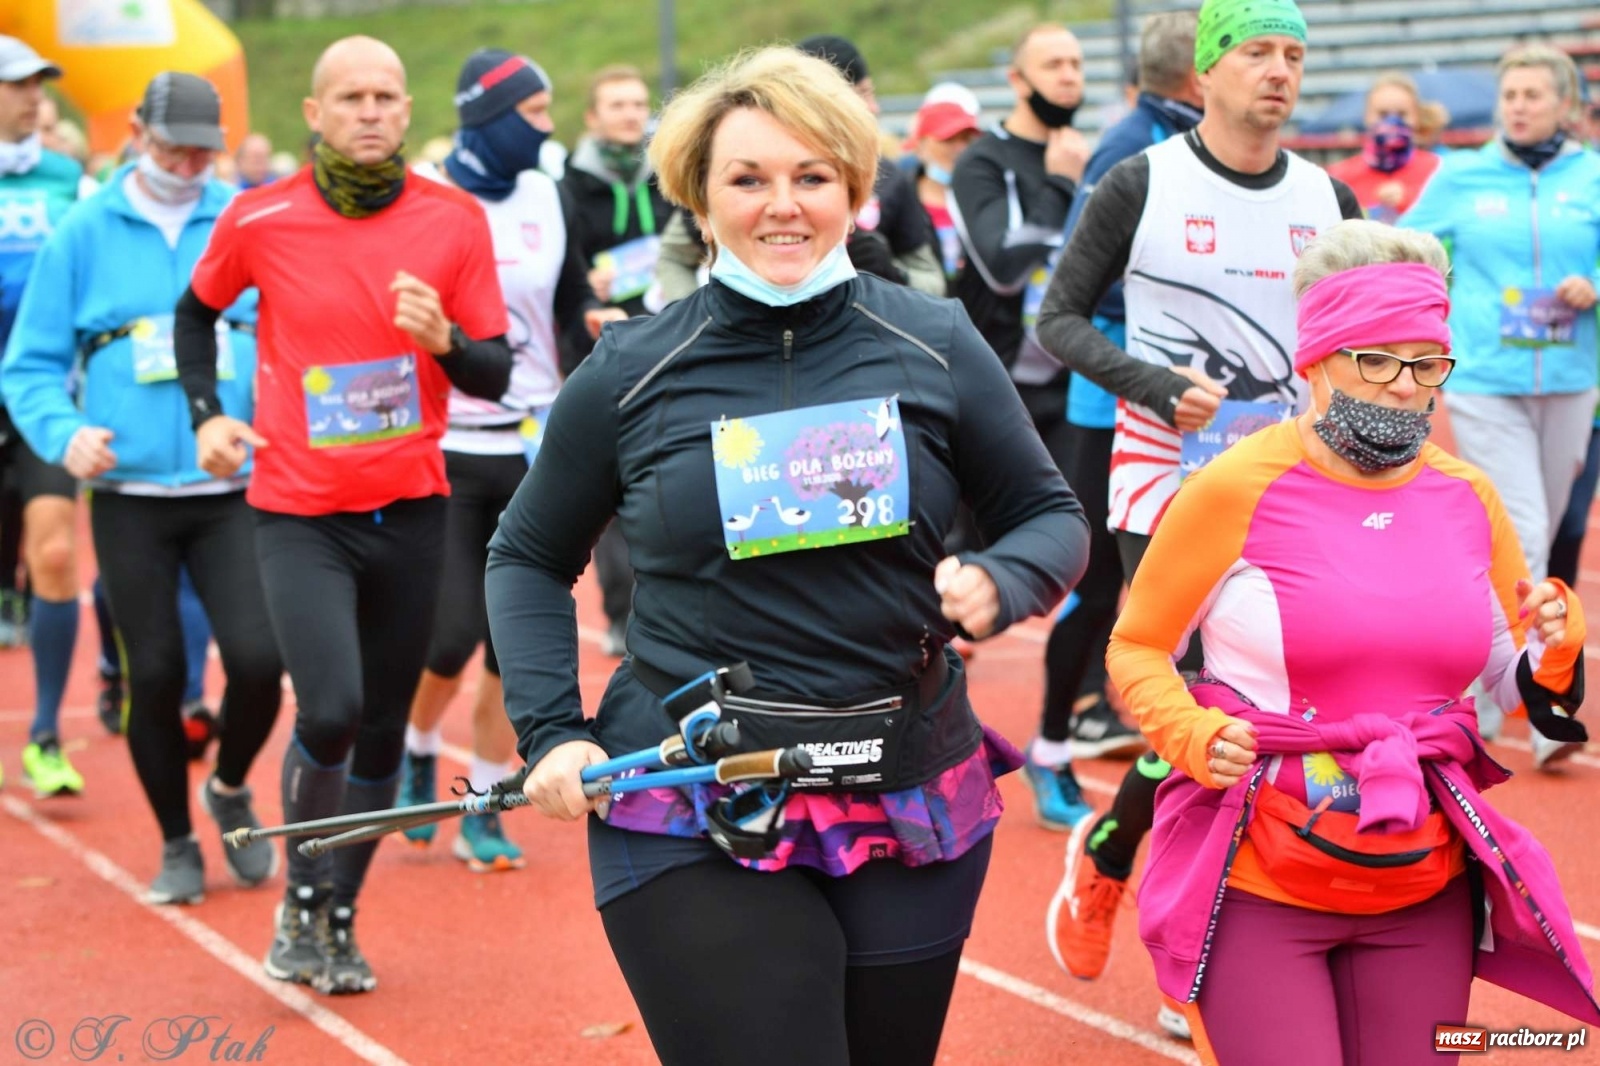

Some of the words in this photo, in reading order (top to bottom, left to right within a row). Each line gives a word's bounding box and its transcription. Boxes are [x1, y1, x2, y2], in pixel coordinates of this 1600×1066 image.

[742, 462, 780, 484] BIEG
[789, 457, 823, 478] DLA
[837, 494, 894, 528] 298
[1361, 512, 1395, 530] 4F
